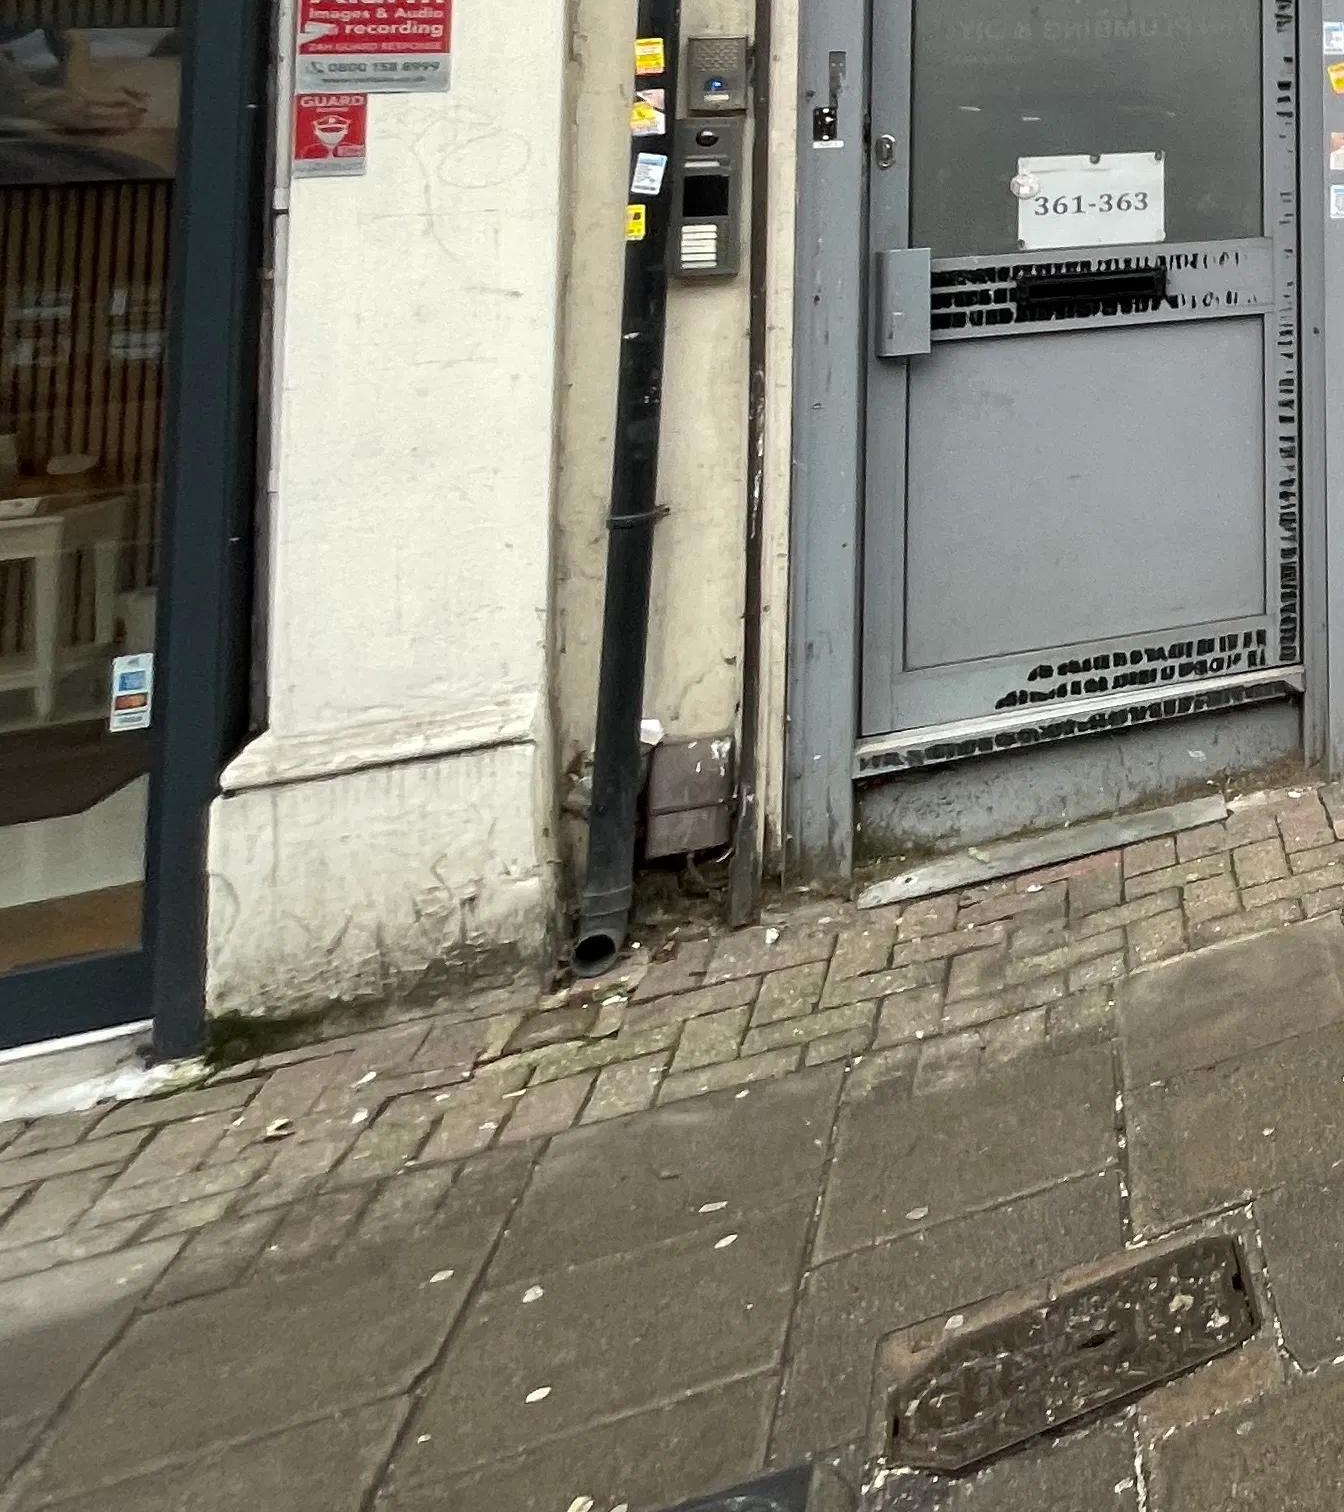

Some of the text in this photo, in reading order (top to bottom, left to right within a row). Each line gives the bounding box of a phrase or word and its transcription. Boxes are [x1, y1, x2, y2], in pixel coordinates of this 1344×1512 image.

[309, 7, 444, 22] Images & Audio
[344, 21, 443, 37] recording
[300, 95, 365, 108] GUARD
[1034, 191, 1149, 217] 361-363
